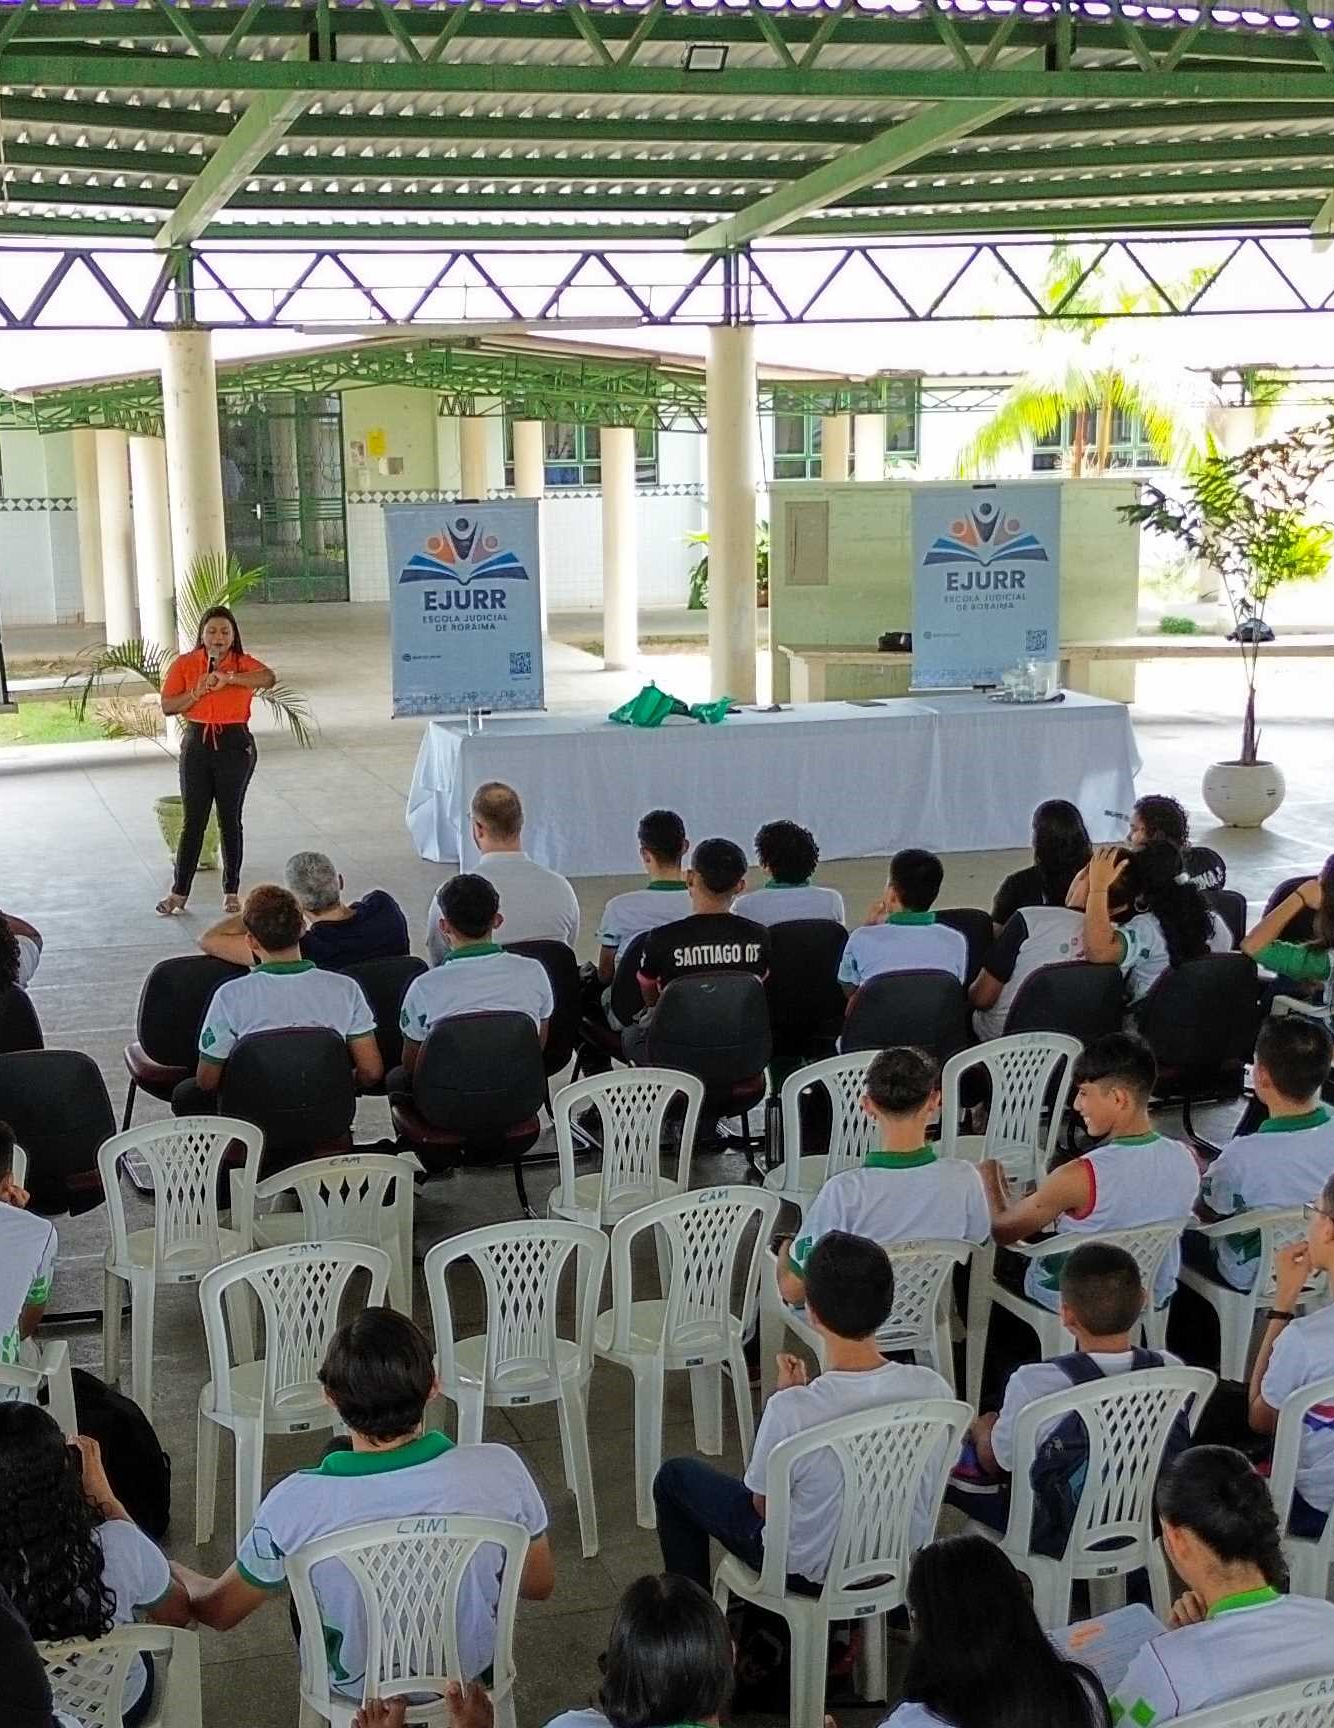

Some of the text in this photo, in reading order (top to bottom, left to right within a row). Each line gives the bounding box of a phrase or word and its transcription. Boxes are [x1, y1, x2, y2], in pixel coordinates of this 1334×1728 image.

[946, 569, 1026, 592] EJURR
[424, 588, 507, 612] EJURR
[422, 613, 508, 624] ESCOLA JUDICIAL
[435, 623, 496, 632] DE RORAIMA
[673, 943, 741, 967] SANTIAGO
[698, 1189, 730, 1204] CAM
